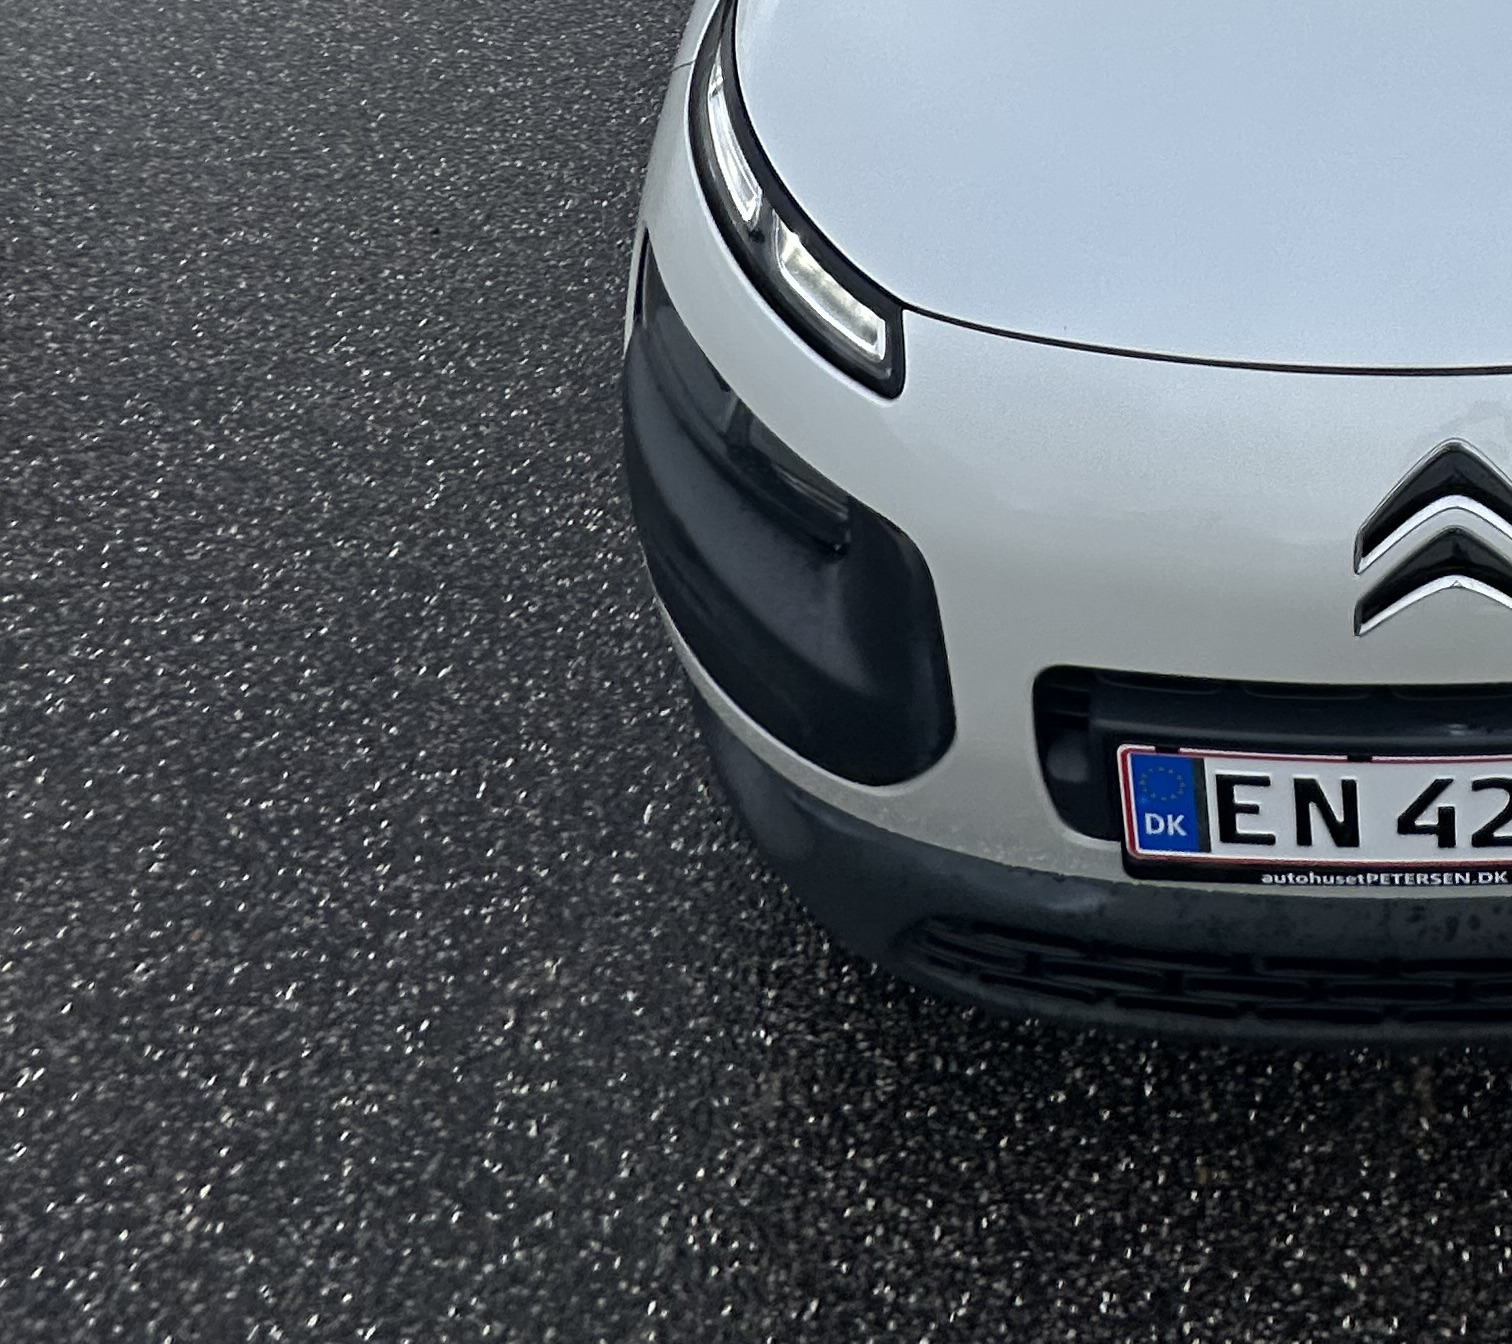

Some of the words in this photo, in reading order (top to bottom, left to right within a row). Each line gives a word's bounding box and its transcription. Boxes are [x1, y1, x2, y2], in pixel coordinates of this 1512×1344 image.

[1215, 772, 1361, 848] EN
[1144, 812, 1188, 838] DK
[1261, 870, 1509, 885] autohusetPETERSEN.DK
